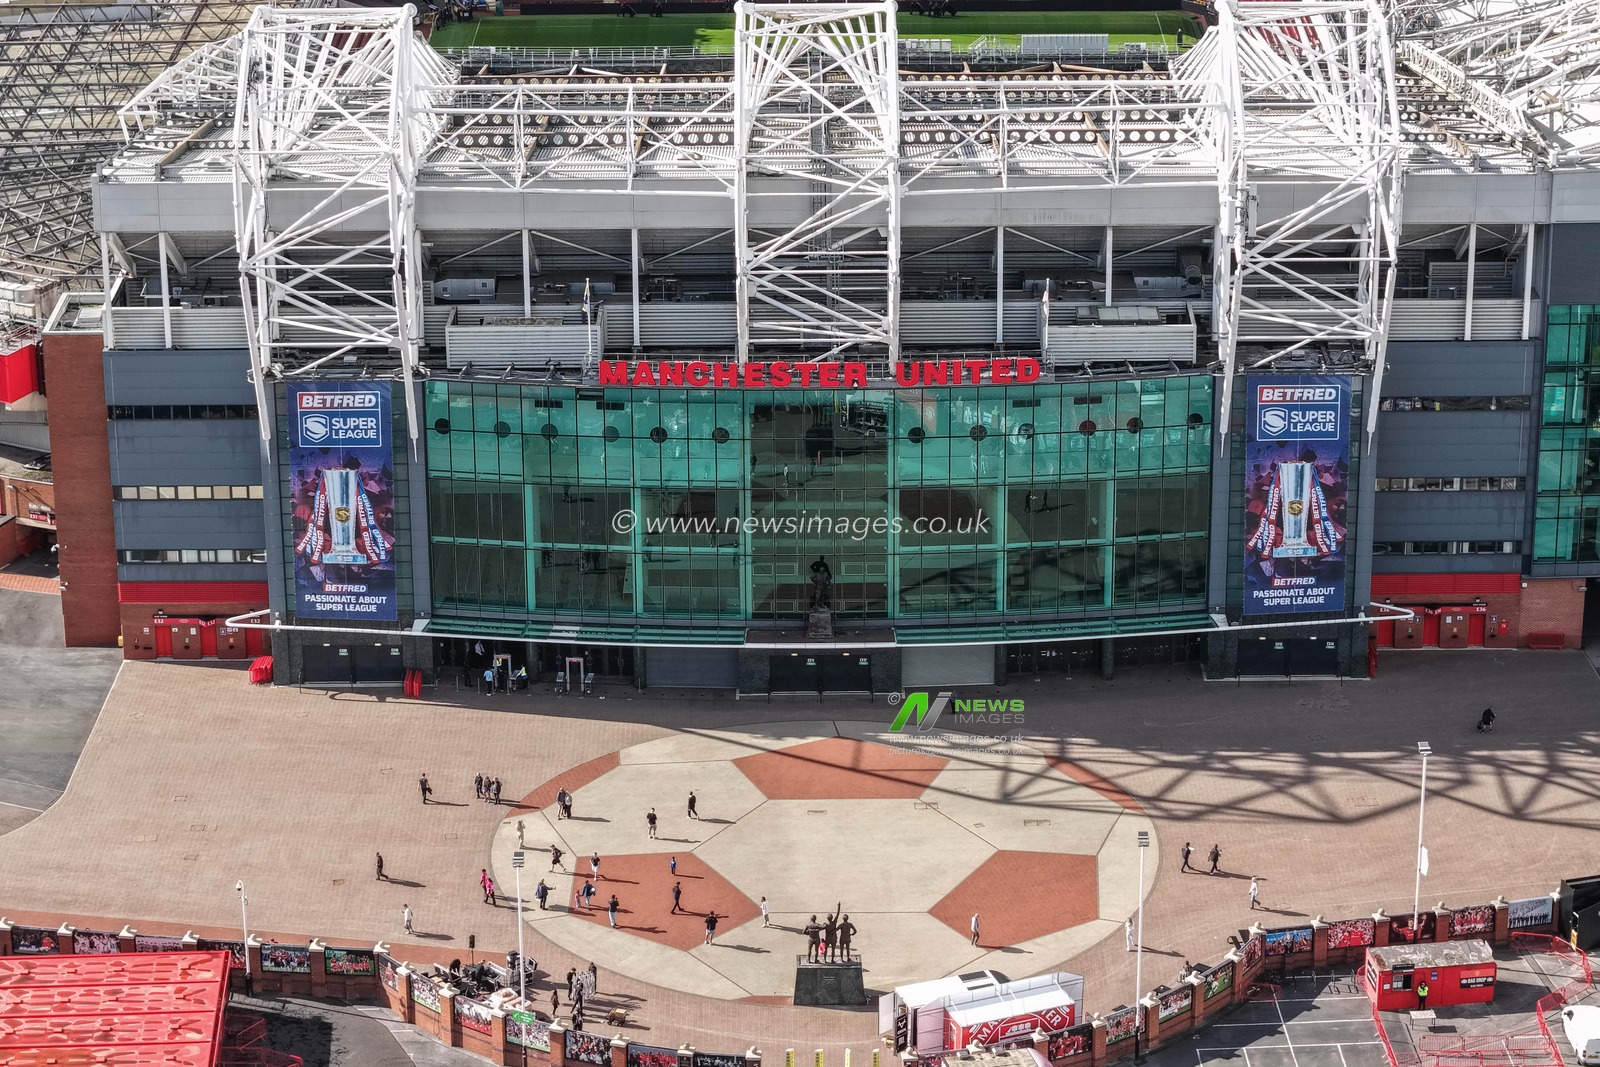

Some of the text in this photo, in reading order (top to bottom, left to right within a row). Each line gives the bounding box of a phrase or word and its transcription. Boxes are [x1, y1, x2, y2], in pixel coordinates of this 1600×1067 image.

[599, 357, 1041, 387] MANCHESTER UNITED
[1261, 388, 1336, 401] BETFRED
[301, 394, 376, 408] BETFRED
[1290, 411, 1336, 422] SUPER
[331, 417, 377, 429] SUPER
[1290, 422, 1335, 432] LEAGUE
[332, 429, 377, 439] LEAGUE
[1269, 487, 1279, 520] BETFRED
[1315, 485, 1328, 517] BETFRED
[297, 522, 314, 551] BETFRED
[1248, 517, 1266, 547] BETFRED
[312, 529, 324, 561] BETFRED
[1262, 524, 1275, 556] BETFRED
[1273, 577, 1316, 586] BETFRED
[325, 584, 367, 592] BETFRED
[1253, 587, 1336, 598] PASSIONATE ABOUT
[304, 594, 387, 604] PASSIONATE ABOUT
[1263, 596, 1325, 606] SUPER LEAGUE
[315, 603, 378, 612] SUPER LEAGUE
